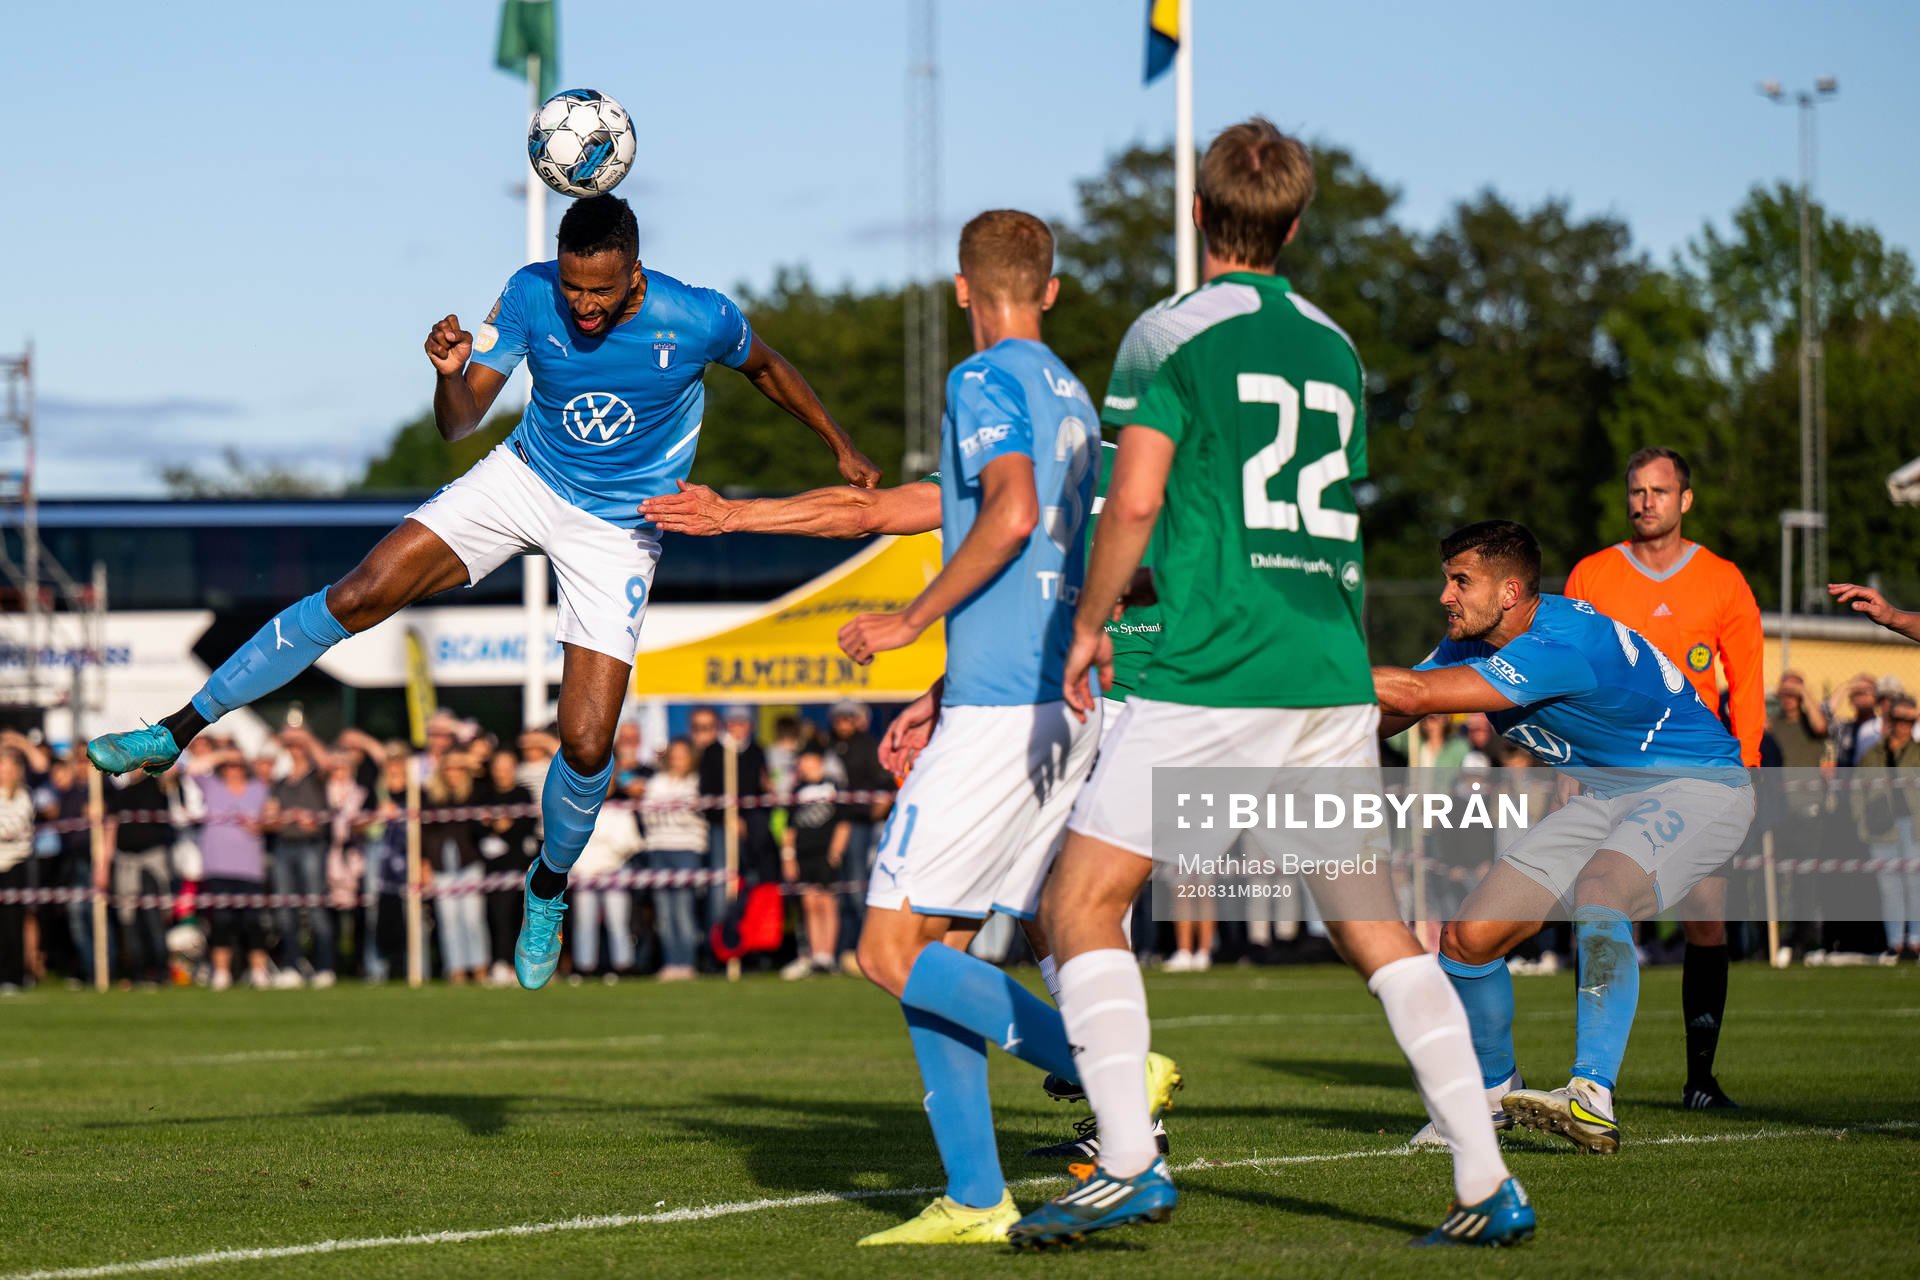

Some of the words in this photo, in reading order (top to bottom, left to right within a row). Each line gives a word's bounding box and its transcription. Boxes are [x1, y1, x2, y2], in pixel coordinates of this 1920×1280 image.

[1236, 373, 1360, 543] 22
[625, 575, 647, 619] 9
[1623, 798, 1685, 843] 23
